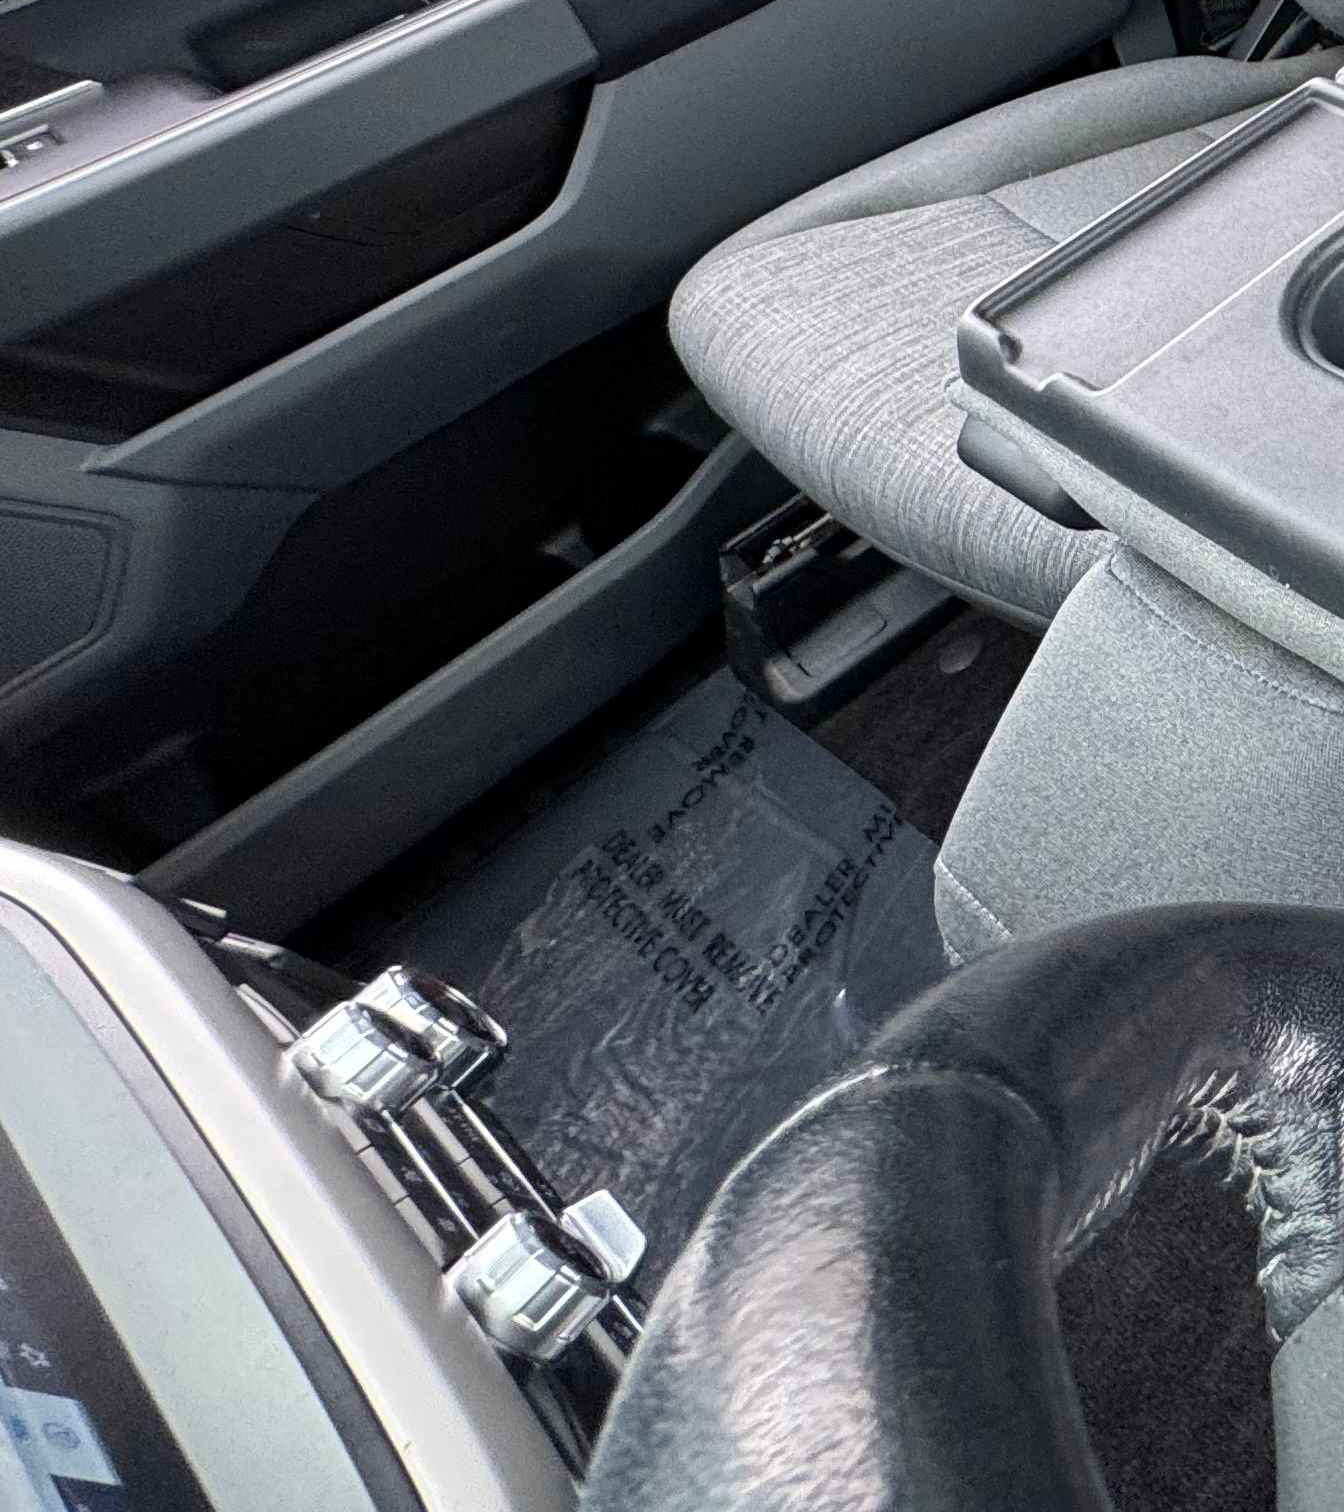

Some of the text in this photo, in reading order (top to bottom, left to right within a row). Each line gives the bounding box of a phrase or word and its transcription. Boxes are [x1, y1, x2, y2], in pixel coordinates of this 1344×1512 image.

[648, 735, 755, 844] REMOVE
[571, 859, 716, 1014] PROTECTIVE COVER
[603, 829, 782, 1017] DEALER MUST REMOVE
[770, 858, 855, 968] DEALER
